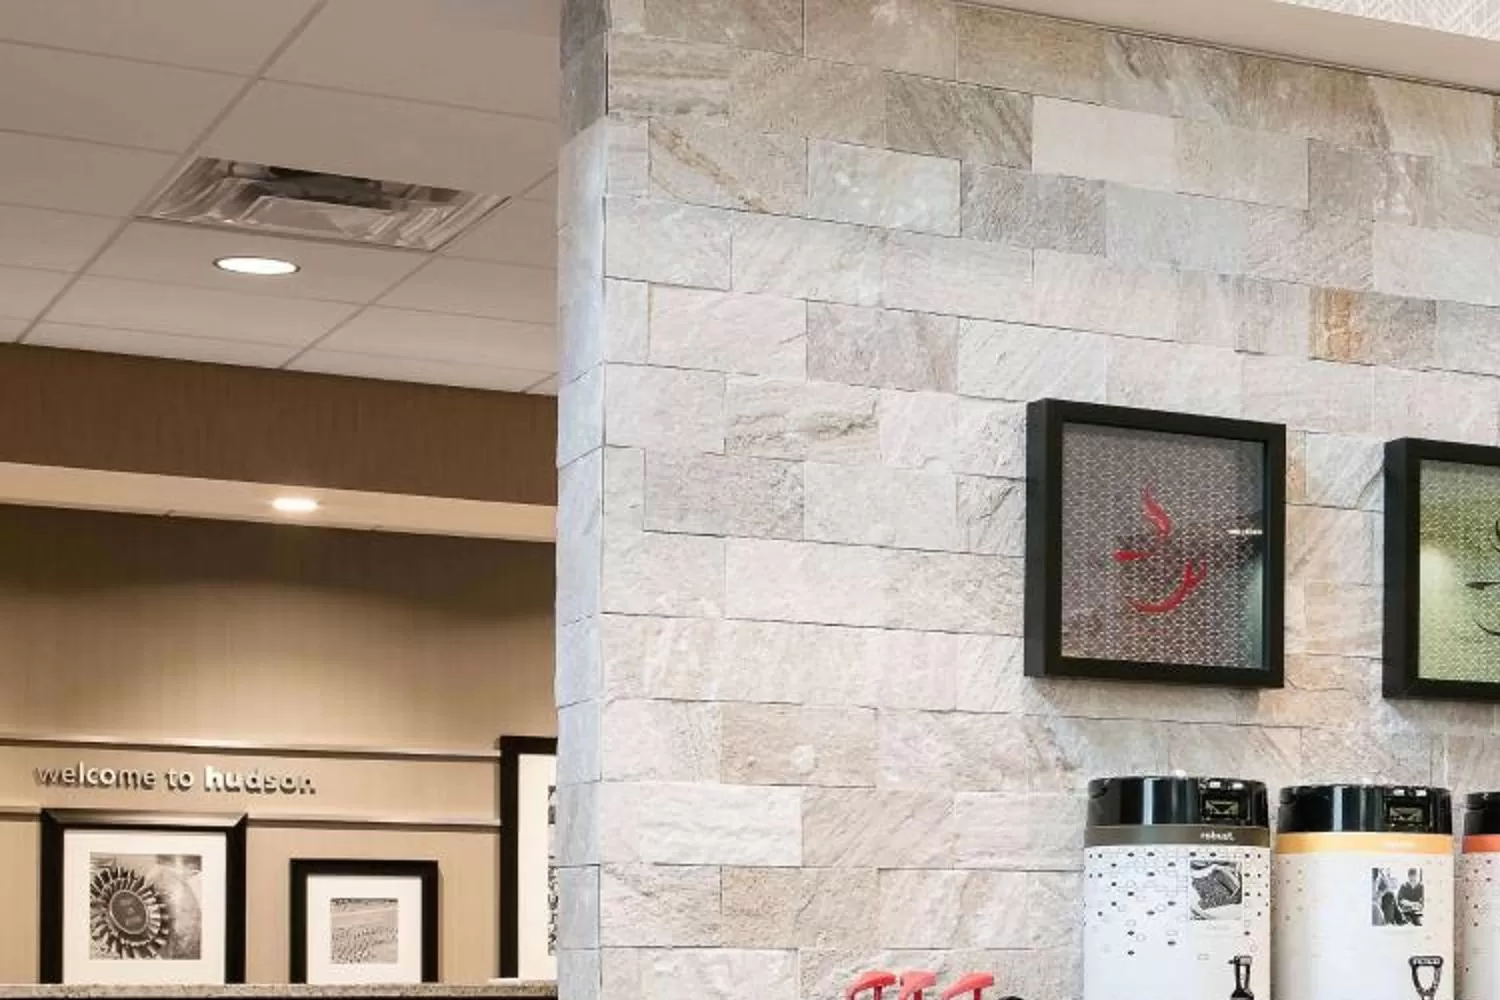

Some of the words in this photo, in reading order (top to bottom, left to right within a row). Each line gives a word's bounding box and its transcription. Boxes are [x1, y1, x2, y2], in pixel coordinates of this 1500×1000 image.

[35, 760, 157, 790] welcome
[166, 767, 195, 791] to
[203, 765, 316, 795] hudson
